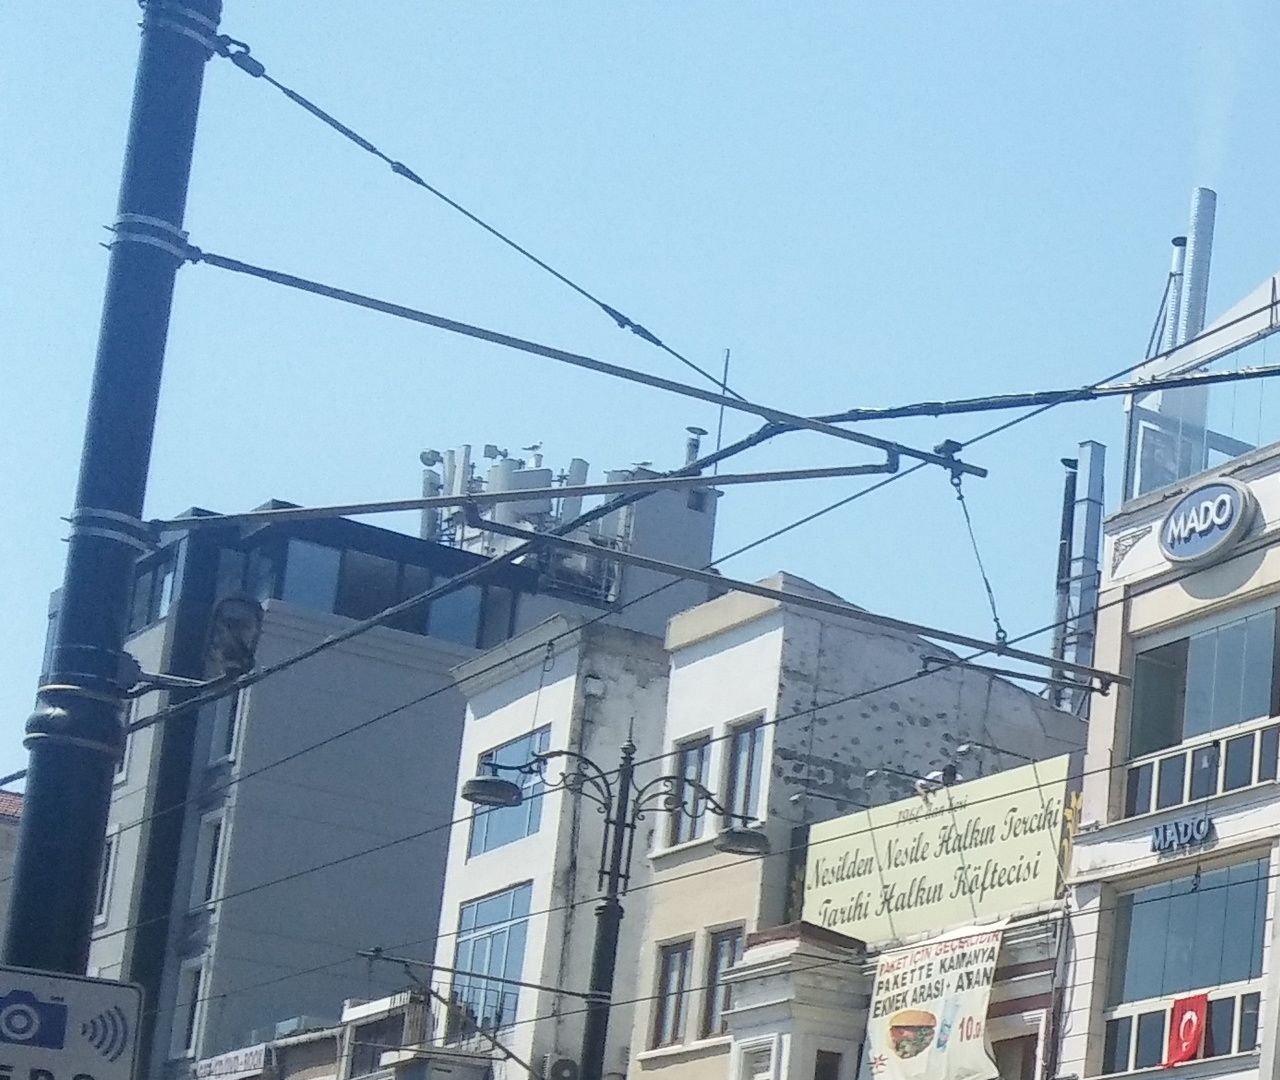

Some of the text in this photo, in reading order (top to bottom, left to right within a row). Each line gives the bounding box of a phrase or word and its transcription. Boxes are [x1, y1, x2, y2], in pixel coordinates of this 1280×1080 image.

[1167, 493, 1232, 544] MADO
[807, 797, 1061, 890] Nesilden Nesile Halkın Tercihi
[1151, 818, 1211, 851] MADO
[819, 851, 1041, 927] Tarihi Halkın Köftecisi
[876, 946, 996, 996] PAKETTE KAMPANYA
[873, 990, 909, 1018] EKMEK
[911, 979, 944, 1006] ARASI
